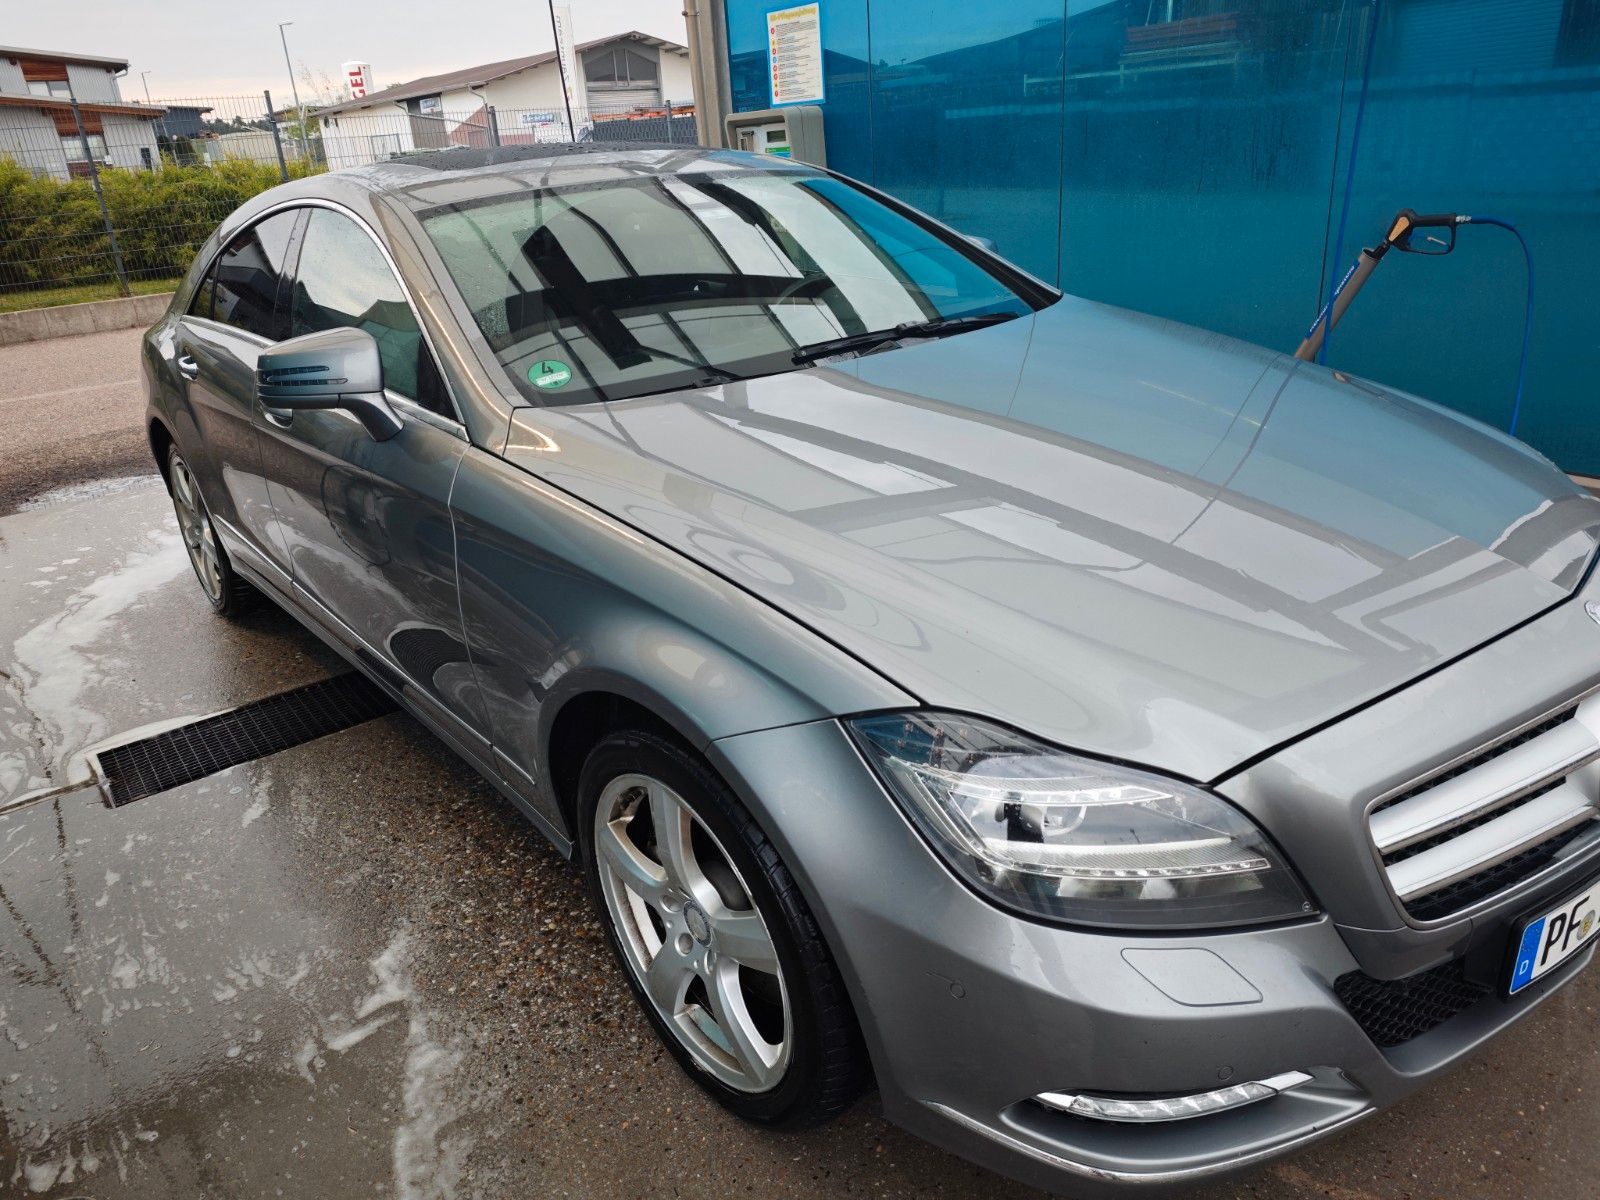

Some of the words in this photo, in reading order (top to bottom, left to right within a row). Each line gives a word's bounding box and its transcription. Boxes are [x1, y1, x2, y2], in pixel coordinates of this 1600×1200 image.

[541, 361, 554, 374] 4
[1540, 895, 1590, 966] PF
[1519, 959, 1529, 976] D
